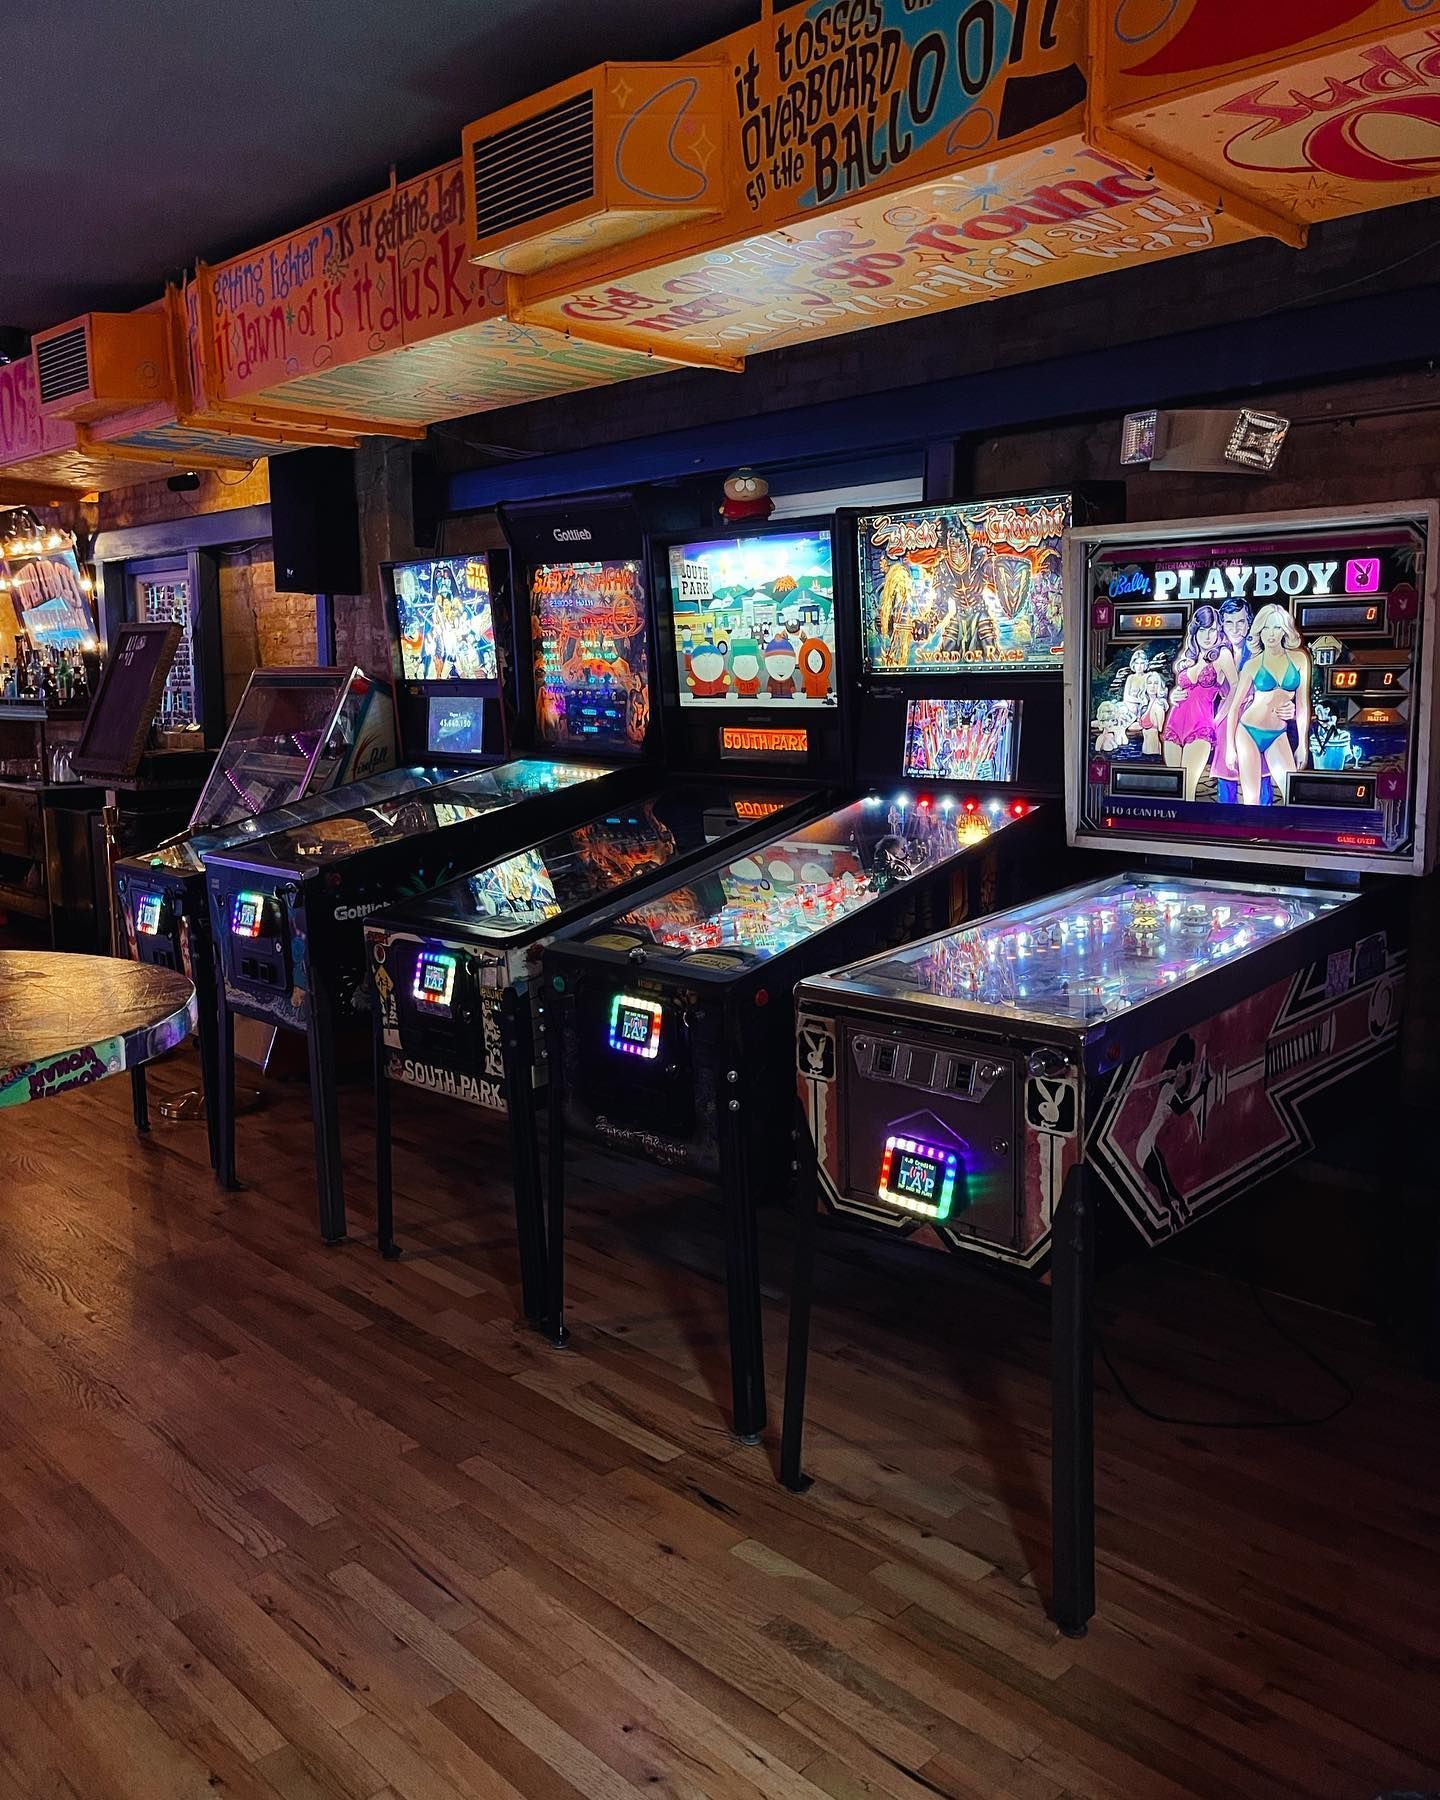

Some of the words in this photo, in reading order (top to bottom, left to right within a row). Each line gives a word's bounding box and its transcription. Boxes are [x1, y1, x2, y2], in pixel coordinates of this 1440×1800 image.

[735, 48, 759, 118] it
[775, 0, 881, 81] tosses
[1071, 216, 1215, 259] way
[213, 258, 264, 317] getting
[359, 204, 372, 247] it
[375, 179, 430, 264] getting
[682, 319, 785, 348] you
[990, 237, 1070, 267] it
[1046, 211, 1134, 243] all
[561, 286, 673, 320] Get
[215, 310, 233, 384] it
[236, 306, 287, 379] dawn
[299, 288, 317, 338] or
[323, 281, 343, 342] is
[353, 262, 374, 332] it
[553, 528, 592, 542] Gottlieb
[970, 503, 1066, 552] Knight
[467, 562, 488, 578] STA
[1155, 560, 1212, 571] ENTERTAINMENT
[1213, 559, 1228, 568] FOR
[1230, 558, 1244, 566] ALL
[682, 580, 709, 594] PARK
[1154, 561, 1338, 600] PLAYBOY
[1135, 616, 1162, 627] 496
[1366, 608, 1376, 620] 0
[914, 648, 960, 664] SWORD
[986, 646, 1025, 662] RAGE
[1384, 672, 1392, 684] 0
[724, 733, 768, 750] SOUTH
[772, 734, 808, 752] PARK
[1356, 786, 1365, 797] 0
[1112, 806, 1123, 814] TO
[1133, 807, 1151, 816] CAN
[1154, 808, 1177, 818] PLAY
[1106, 818, 1112, 826] 1
[425, 975, 444, 988] TAP
[623, 1022, 648, 1038] TAP
[404, 1059, 456, 1094] SOUTH
[459, 1074, 502, 1105] PARK
[900, 1168, 934, 1192] TAP
